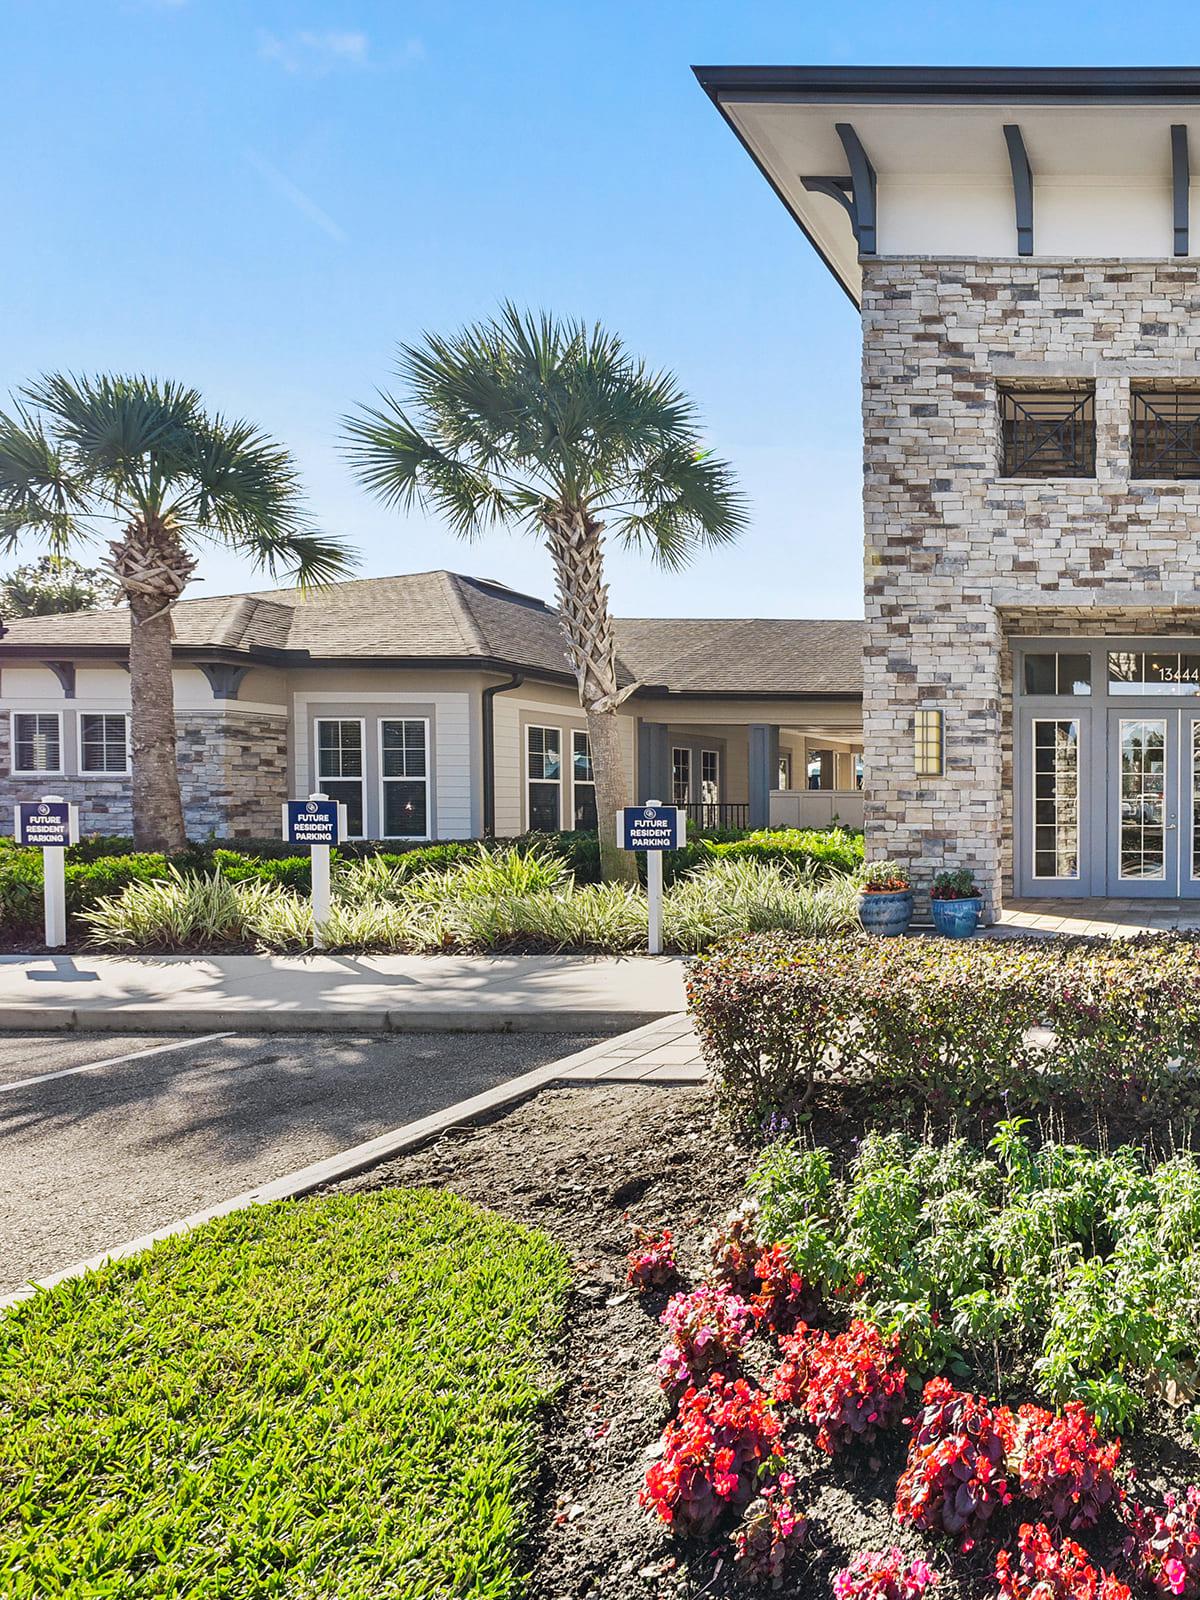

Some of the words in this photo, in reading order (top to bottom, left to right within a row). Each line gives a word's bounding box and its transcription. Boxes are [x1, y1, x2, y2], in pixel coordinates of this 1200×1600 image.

[1158, 667, 1199, 681] 13444
[29, 816, 61, 824] FUTURE
[297, 814, 329, 822] FUTURE
[293, 823, 333, 831] RESIDENT
[634, 820, 668, 828] FUTURE
[25, 825, 65, 833] RESIDENT
[630, 829, 672, 837] RESIDENT
[27, 834, 64, 842] PARKING
[295, 832, 332, 841] PARKING
[632, 838, 670, 846] PARKING
